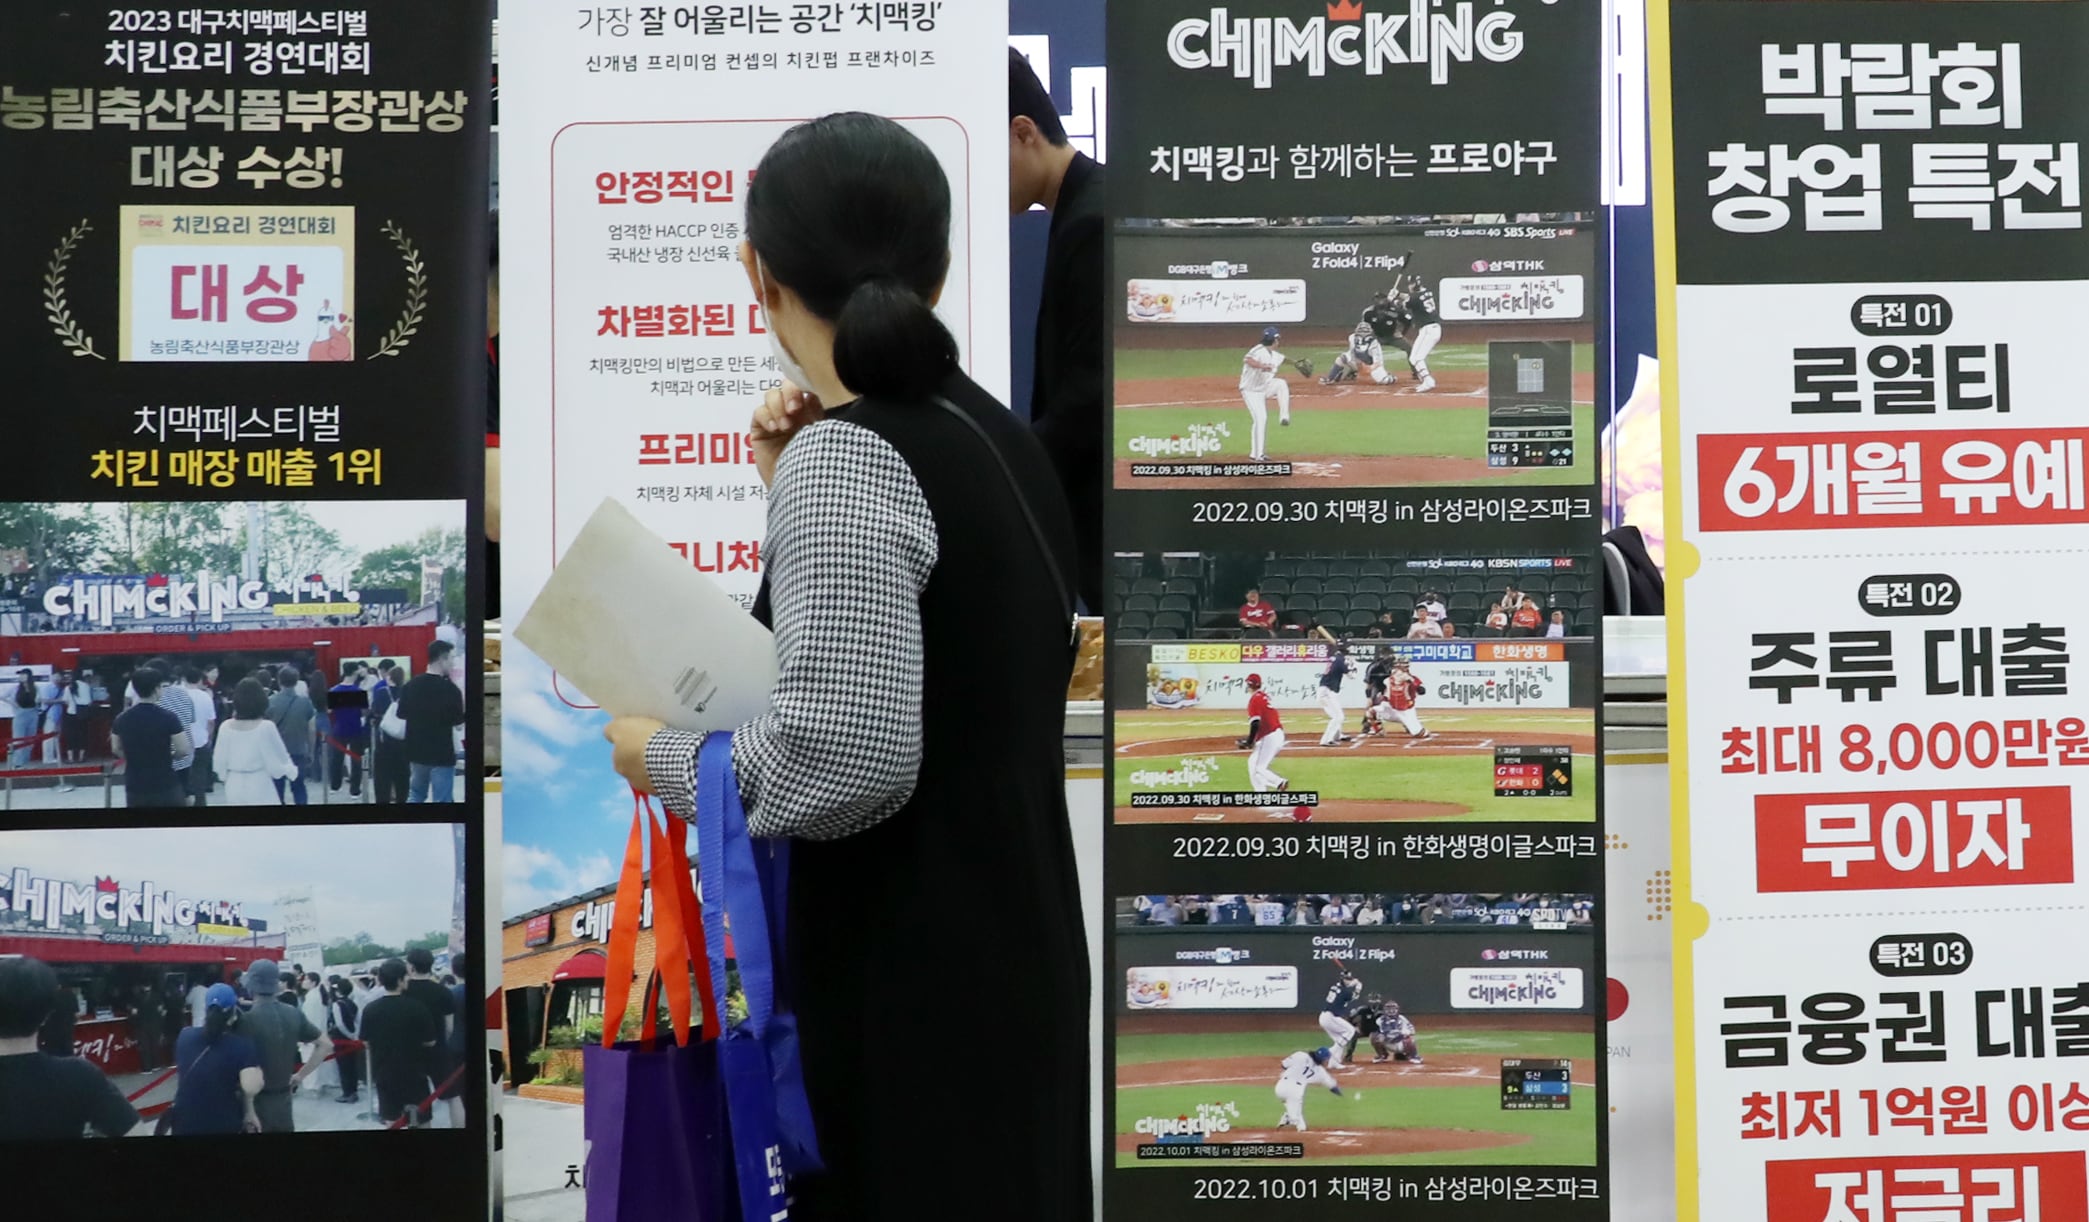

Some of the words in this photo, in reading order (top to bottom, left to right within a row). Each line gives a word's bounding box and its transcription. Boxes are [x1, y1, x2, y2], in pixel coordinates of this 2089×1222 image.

[108, 10, 171, 32] 2023
[178, 9, 367, 36] 대구치맥페스티벌
[578, 8, 631, 37] 가장
[639, 7, 666, 35] 잘
[674, 5, 782, 34] 어울리는
[789, 5, 843, 32] 공간
[104, 41, 232, 74] 치킨요리
[244, 40, 370, 75] 경연대회
[586, 53, 638, 73] 신개념
[647, 53, 716, 72] 프리미엄
[726, 52, 778, 71] 컨셉의
[787, 51, 838, 69] 치킨펍
[847, 50, 936, 68] 프랜차이즈
[1762, 42, 2022, 131] 박람회
[0, 86, 468, 132] 농림축산식품부장관상
[130, 146, 224, 188] 대상
[237, 147, 344, 189] 수상!
[1150, 144, 1279, 182] 치맥킹과
[1289, 143, 1418, 179] 함께하는
[1426, 140, 1558, 176] 프로야구
[596, 170, 733, 204] 안정적인
[1708, 143, 1882, 233] 창업
[1908, 142, 2083, 231] 특전
[172, 216, 250, 234] 치킨요리
[259, 216, 335, 234] 경연대회
[608, 224, 652, 240] 엄격한
[656, 225, 706, 238] HACCP
[711, 223, 739, 238] 인증
[1504, 227, 1525, 238] SBS
[1525, 227, 1556, 239] Sports
[1559, 228, 1575, 236] LIVE
[607, 247, 651, 263] 국내산
[655, 247, 683, 263] 냉장
[688, 246, 730, 263] 신선육
[1311, 241, 1359, 255] Galaxy
[1312, 258, 1320, 268] Z
[1322, 257, 1358, 269] Fold4
[1364, 257, 1373, 268] Z
[1374, 256, 1405, 271] Flip4
[597, 304, 735, 337] 차별화된
[1860, 302, 1907, 328] 특전
[1914, 303, 1942, 327] 01
[150, 339, 300, 355] 농림축산식품부장관상
[590, 357, 662, 374] 치맥킹만의
[667, 356, 725, 373] 비법으로
[728, 356, 757, 372] 만든
[651, 380, 693, 396] 치맥과
[697, 379, 756, 395] 어울리는
[1791, 343, 2011, 415] 로열티
[133, 405, 341, 442] 치맥페스티벌
[1511, 443, 1519, 452] 3
[1511, 456, 1519, 465] 9
[90, 449, 159, 487] 치킨
[169, 448, 239, 487] 매장
[247, 448, 317, 486] 매출
[328, 448, 382, 485] 1위
[1133, 465, 1185, 475] 2022.09.30
[1187, 465, 1211, 475] 치맥킹
[1213, 465, 1222, 474] in
[1223, 465, 1290, 475] 삼성라이온즈파크
[1723, 441, 1923, 518] 6개월
[1940, 438, 2087, 514] 유예
[637, 486, 680, 502] 치맥킹
[684, 486, 712, 501] 자체
[717, 485, 745, 501] 시설
[1192, 502, 1318, 523] 2022.09.30
[1325, 499, 1388, 524] 치맥킹
[1395, 500, 1413, 520] in
[1421, 497, 1592, 524] 삼성라이온즈파크
[667, 540, 760, 573] 니처
[1488, 559, 1518, 568] KBSN
[1519, 559, 1551, 567] SPORTS
[1554, 559, 1573, 567] LIVE
[1865, 582, 1913, 608] 특전
[1921, 582, 1954, 606] 02
[1188, 648, 1240, 660] BESKO
[1492, 645, 1548, 659] 한화생명
[1749, 630, 1897, 704] 주류
[1924, 623, 2070, 697] 대출
[1721, 725, 1822, 775] 최대
[1839, 716, 2089, 775] 8,000만원
[1133, 795, 1190, 806] 2022.09.30
[1193, 795, 1220, 806] 치맥킹
[1223, 796, 1232, 804] in
[1234, 794, 1317, 806] 한화생명이글스파크
[1173, 837, 1300, 858] 2022.09.30
[1306, 834, 1370, 859] 치맥킹
[1377, 835, 1396, 856] in
[1403, 833, 1597, 859] 한화생명이글스파크
[1802, 798, 2031, 878] 무이자
[1312, 936, 1354, 949] Galaxy
[1312, 949, 1320, 959] Z
[1322, 949, 1353, 960] Fold4
[1359, 949, 1368, 960] Z
[1368, 949, 1395, 962] Flip4
[1877, 942, 1925, 968] 특전
[1933, 941, 1966, 966] 03
[1720, 990, 1948, 1069] 금융권
[1740, 1089, 1841, 1140] 최저
[1858, 1085, 1988, 1137] 1억원
[1140, 1147, 1191, 1156] 2022.10.01
[1194, 1146, 1219, 1156] 치맥킹
[1222, 1146, 1230, 1155] in
[1232, 1146, 1301, 1156] 삼성라이온즈파크
[1194, 1179, 1318, 1200] 2022.10.01
[1327, 1177, 1391, 1201] 치맥킹
[1400, 1178, 1418, 1199] in
[1425, 1176, 1600, 1201] 삼성라이온즈파크
